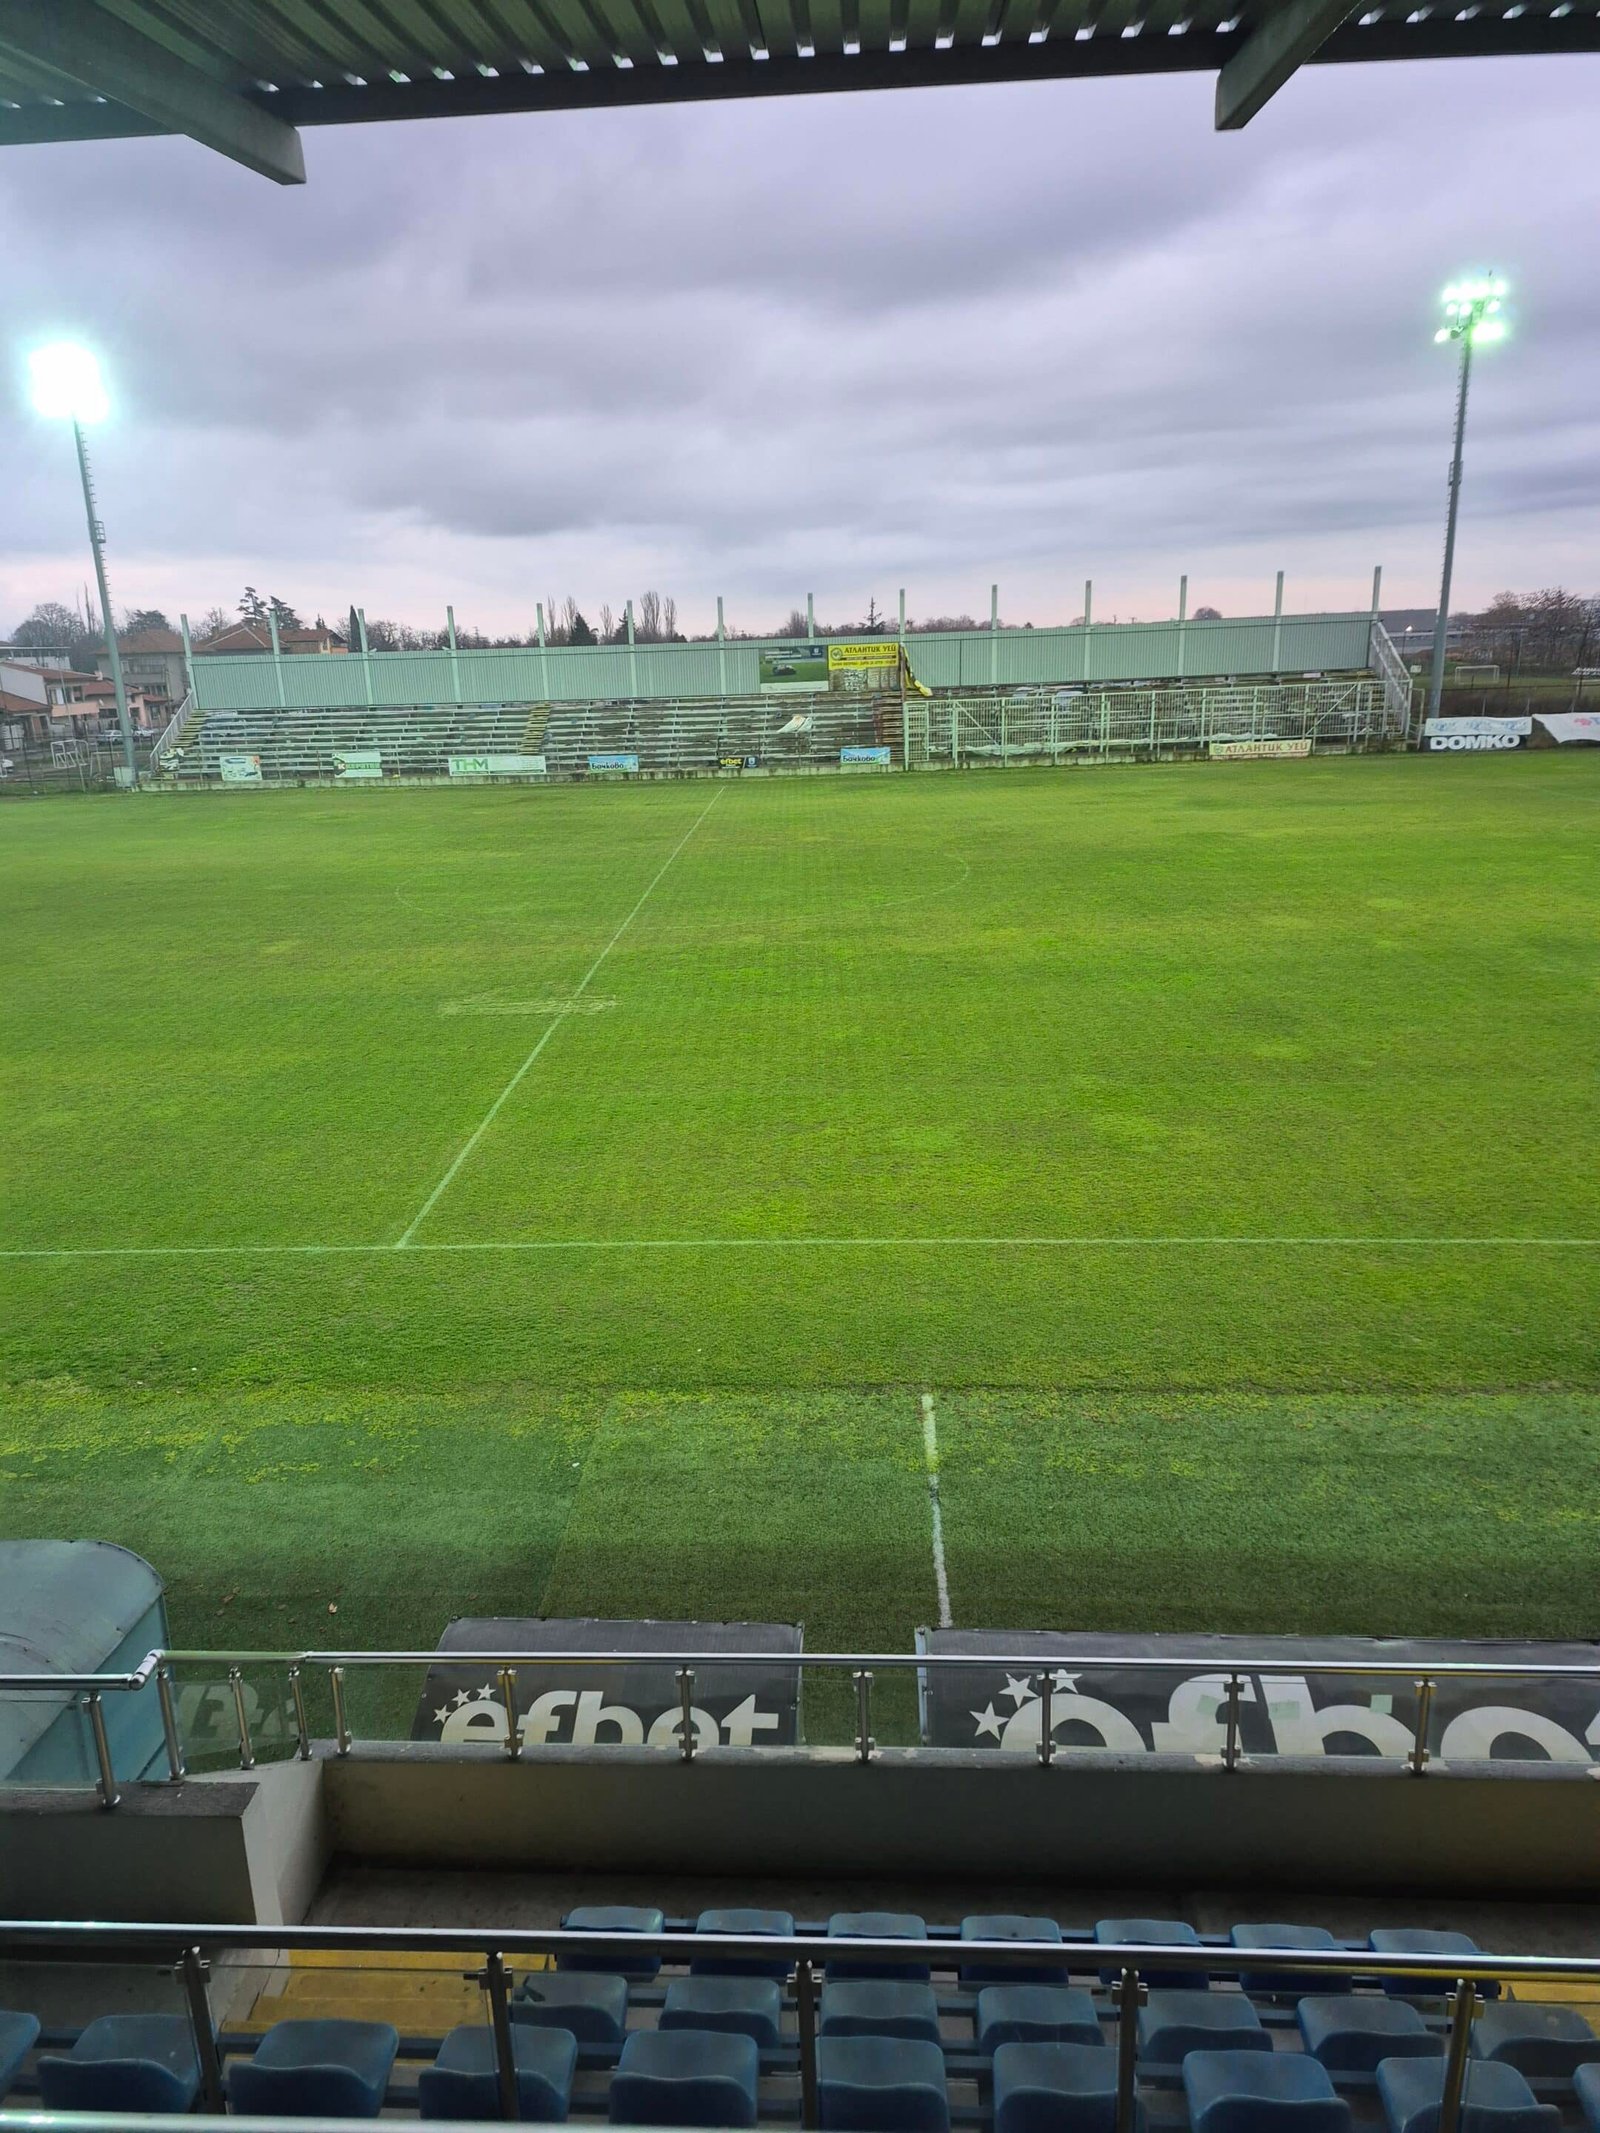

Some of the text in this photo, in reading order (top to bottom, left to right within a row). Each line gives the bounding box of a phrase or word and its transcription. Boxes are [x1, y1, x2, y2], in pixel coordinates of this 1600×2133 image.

[1430, 735, 1521, 750] DOMKO
[451, 758, 489, 771] THM
[441, 1691, 779, 1746] efbet
